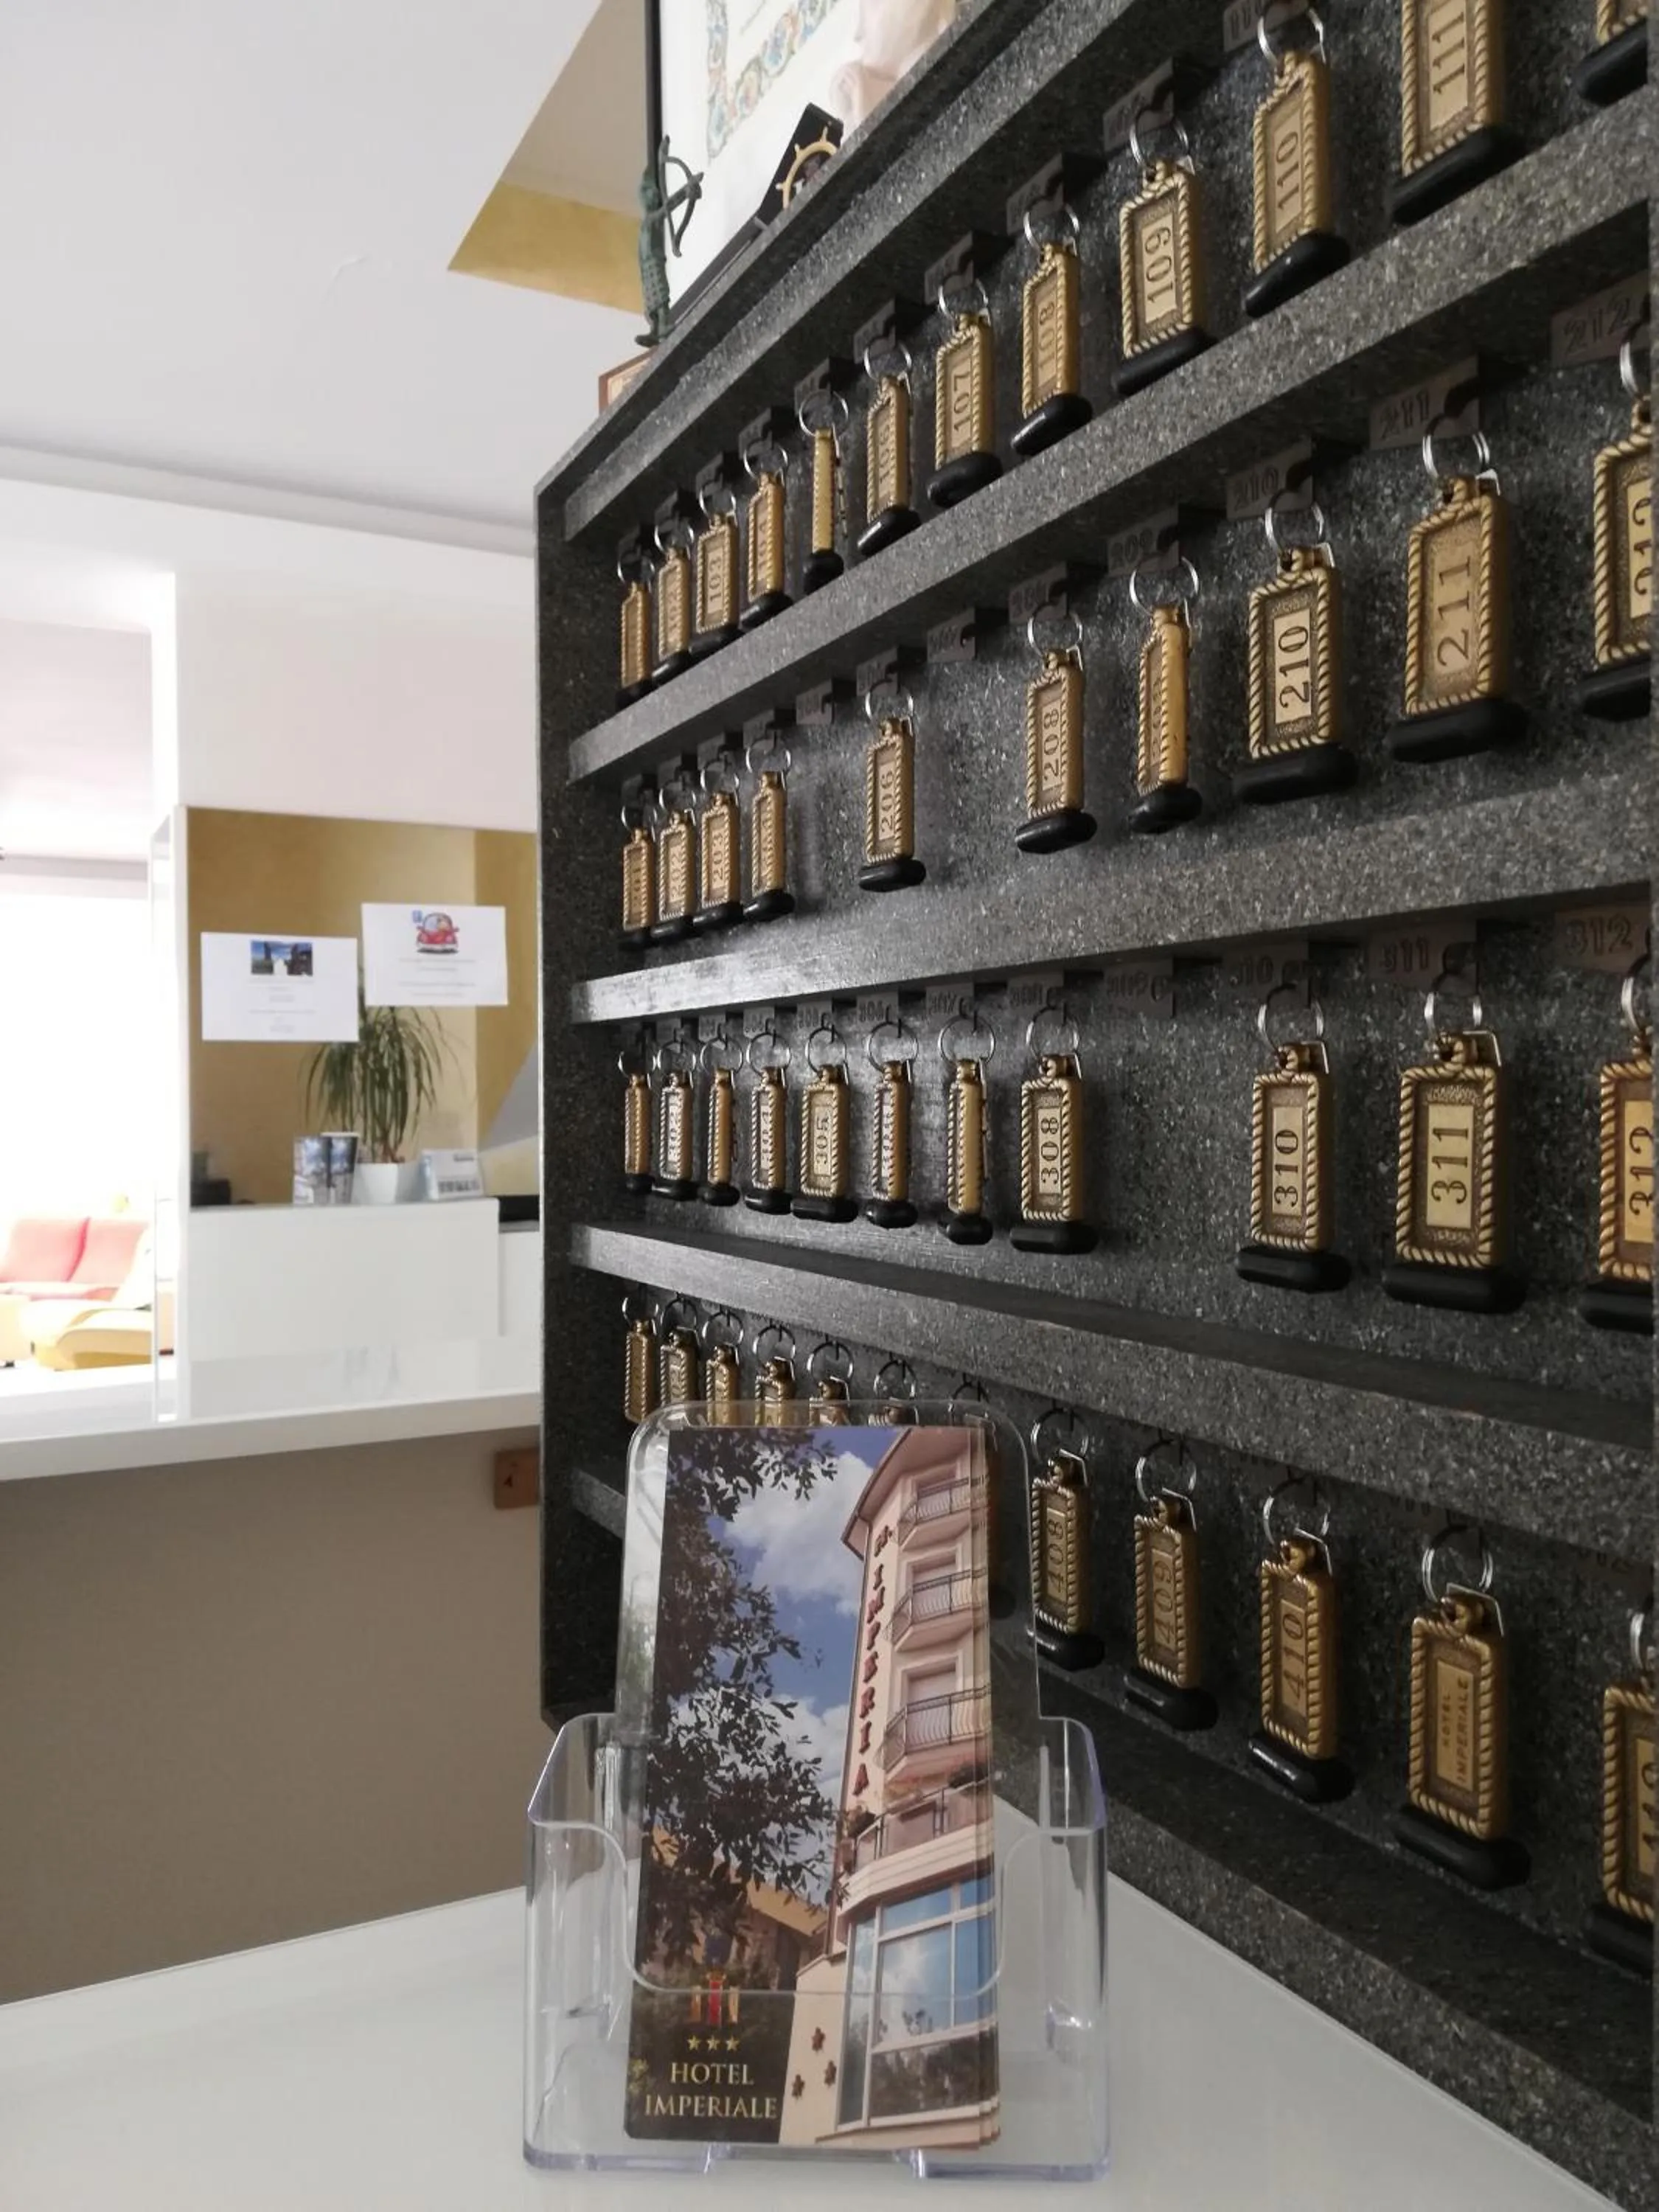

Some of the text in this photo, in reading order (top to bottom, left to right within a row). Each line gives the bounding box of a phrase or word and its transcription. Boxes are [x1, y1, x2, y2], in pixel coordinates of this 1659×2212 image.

[1431, 11, 1466, 94] 111
[1276, 131, 1300, 210] 110
[1144, 226, 1173, 304] 109
[1039, 301, 1056, 370] 108
[953, 374, 970, 431] 107
[709, 557, 721, 602] 103
[1436, 554, 1470, 667] 211
[1278, 626, 1309, 709] 210
[1043, 708, 1060, 781] 208
[880, 771, 893, 832] 206
[713, 835, 723, 880] 203
[1384, 936, 1430, 973] 311
[1565, 914, 1632, 956] 312
[815, 1116, 828, 1164] 305
[1040, 1117, 1059, 1185] 308
[1273, 1129, 1298, 1208] 310
[1431, 1127, 1468, 1204] 311
[1048, 1520, 1065, 1593] 408
[1152, 1560, 1174, 1644] 409
[1282, 1613, 1304, 1700] 410
[1441, 1692, 1451, 1748] HOTEL
[1455, 1676, 1468, 1784] IMPERIALE
[644, 2094, 777, 2118] IMPERIALE
[670, 2062, 755, 2085] HOTEL
